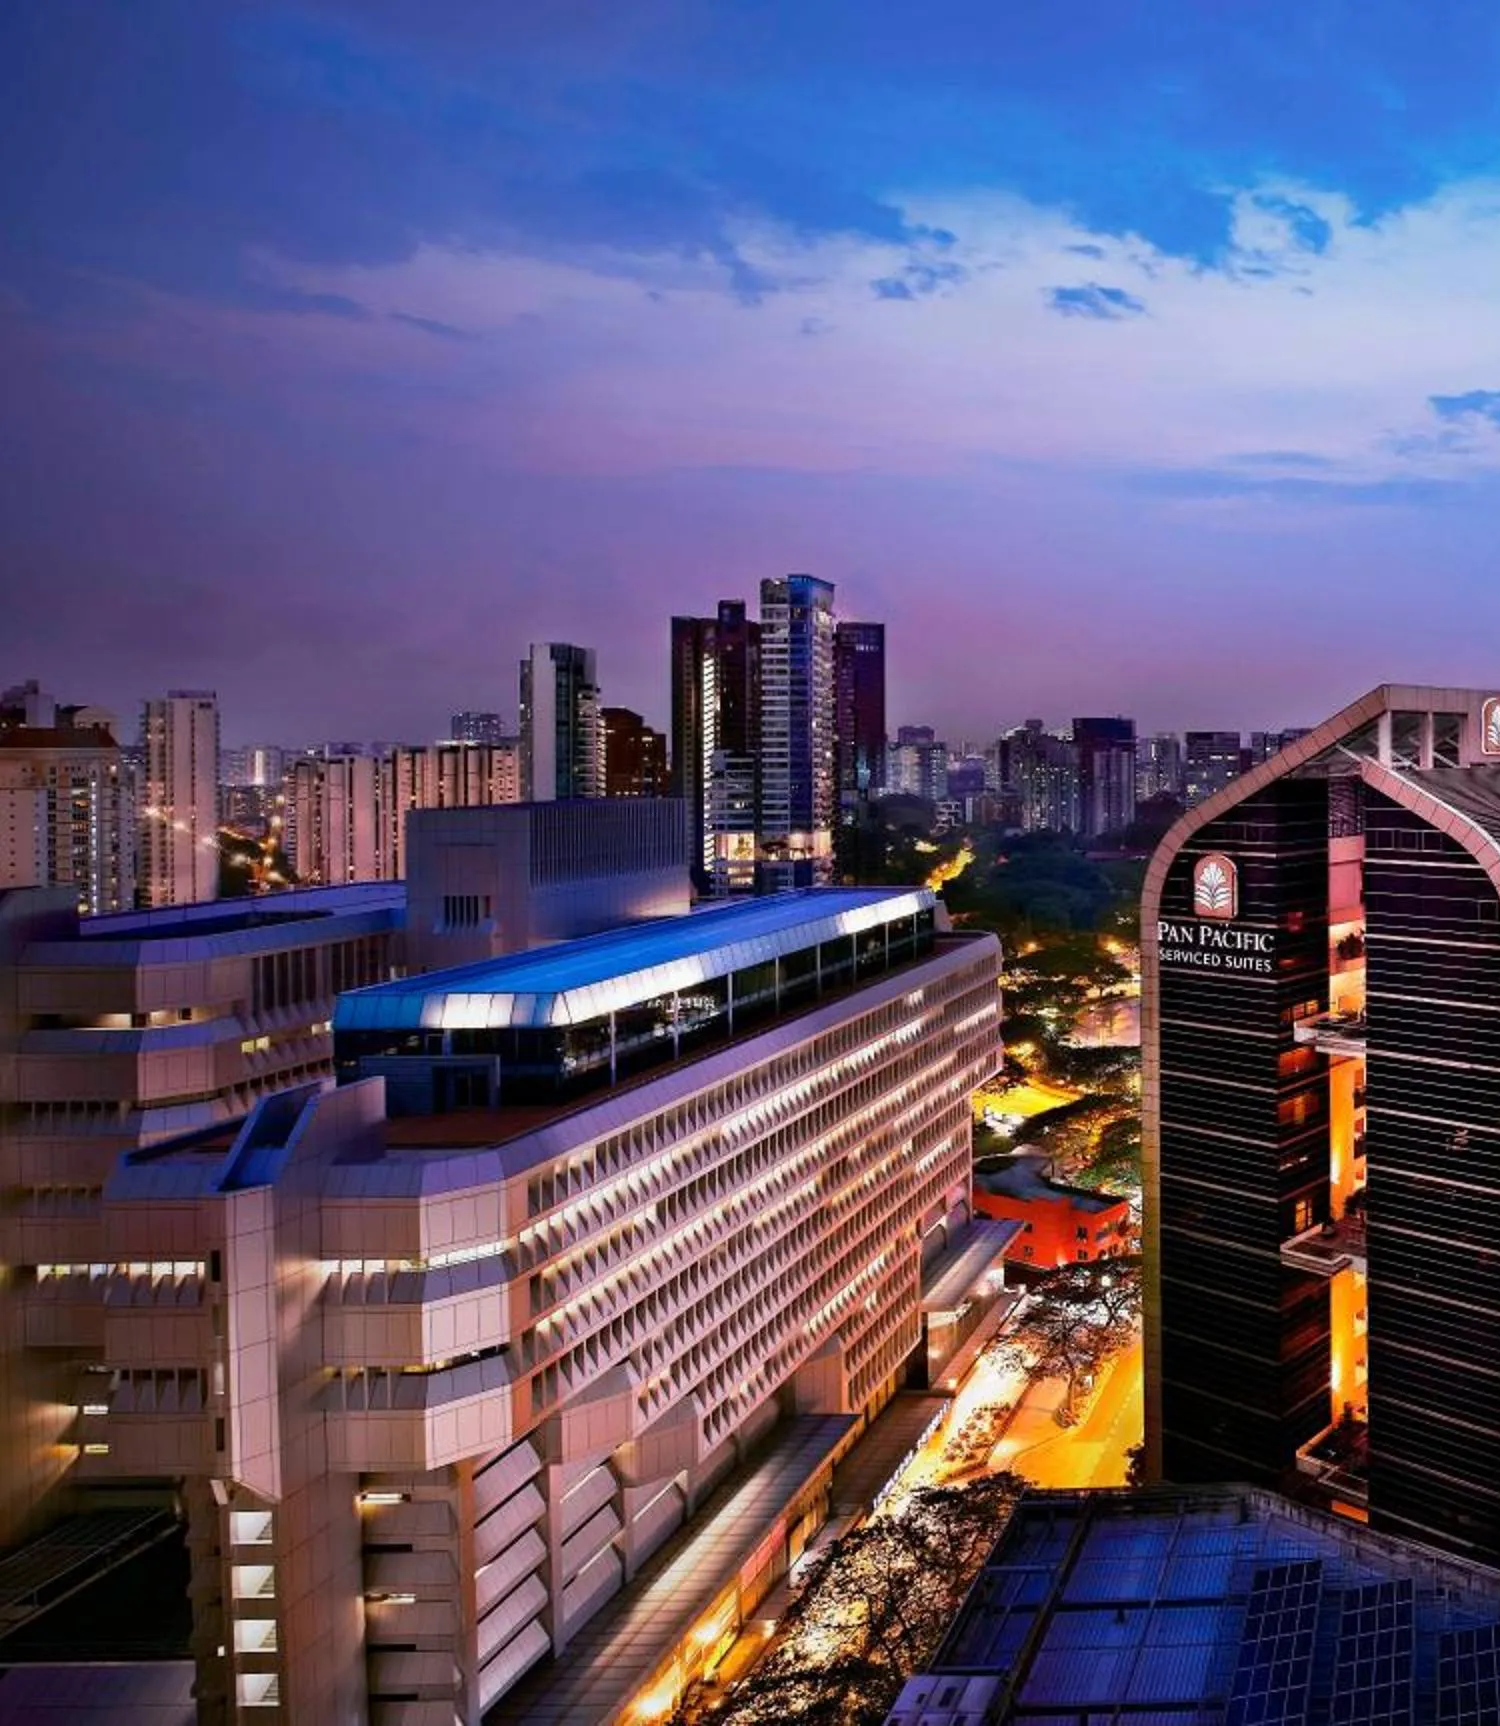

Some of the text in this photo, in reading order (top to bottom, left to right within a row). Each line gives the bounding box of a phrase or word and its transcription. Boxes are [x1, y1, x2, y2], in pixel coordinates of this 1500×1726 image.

[1158, 921, 1275, 953] PAN PACIFIC
[1159, 948, 1273, 973] SERVICED SUITES
